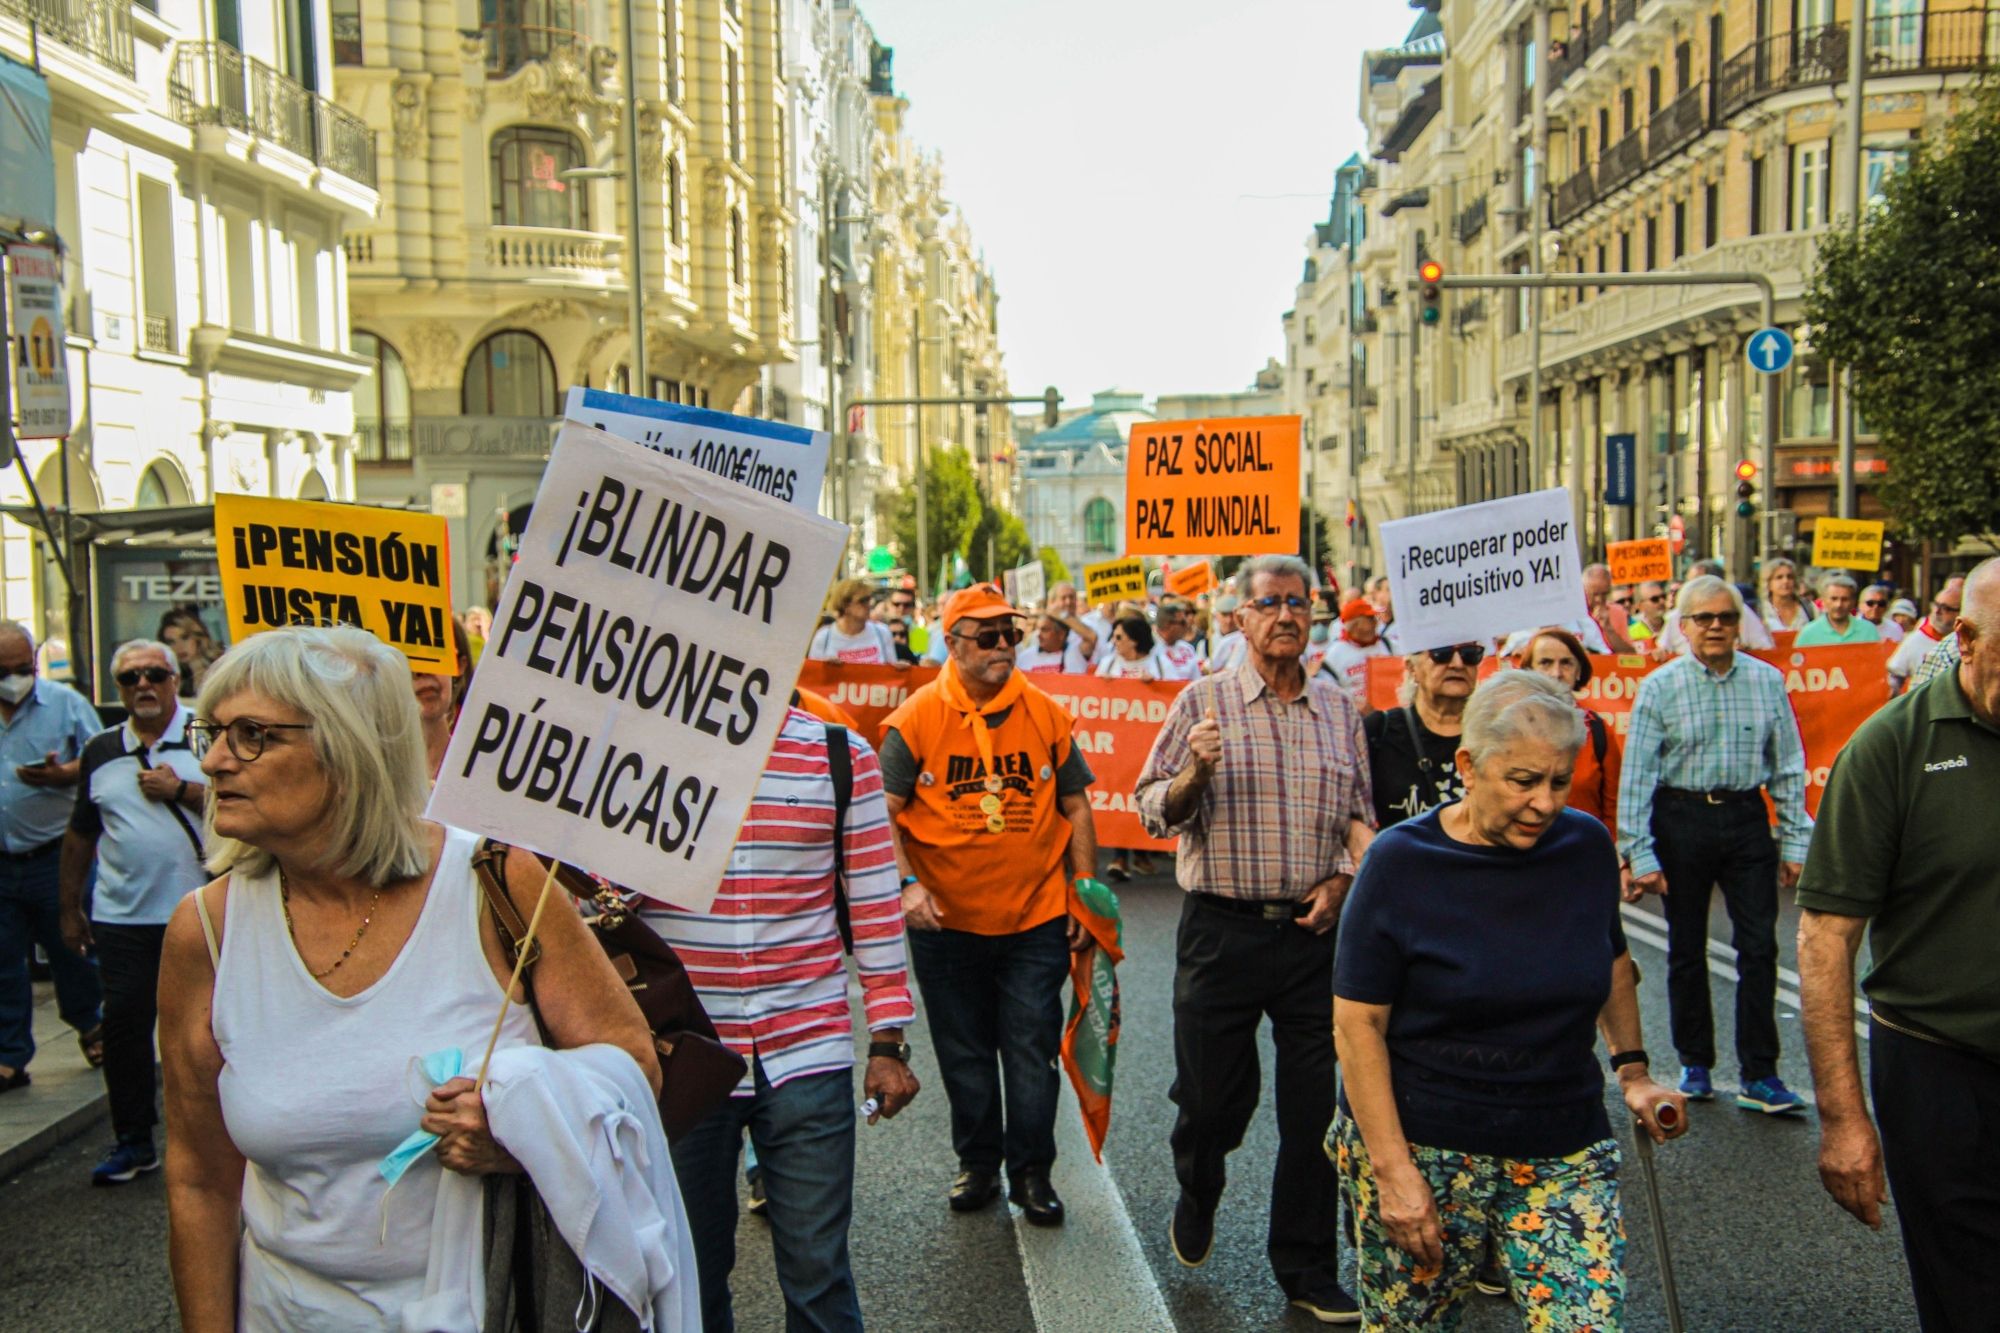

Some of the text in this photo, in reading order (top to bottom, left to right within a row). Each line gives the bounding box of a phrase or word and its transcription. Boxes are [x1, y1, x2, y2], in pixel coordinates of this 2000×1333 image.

[1145, 430, 1273, 477] PAZ SOCIAL.
[1136, 494, 1280, 539] PAZ MUNDIAL.
[232, 522, 441, 588] ¡PENSIÓN
[556, 474, 791, 624] ¡BLINDAR
[1402, 519, 1569, 579] ¡Recuperar poder
[1419, 555, 1561, 607] adquisitivo YA!
[380, 599, 446, 649] YA!
[496, 580, 770, 746] PENSIONES
[462, 697, 719, 861] PÚBLICAS!
